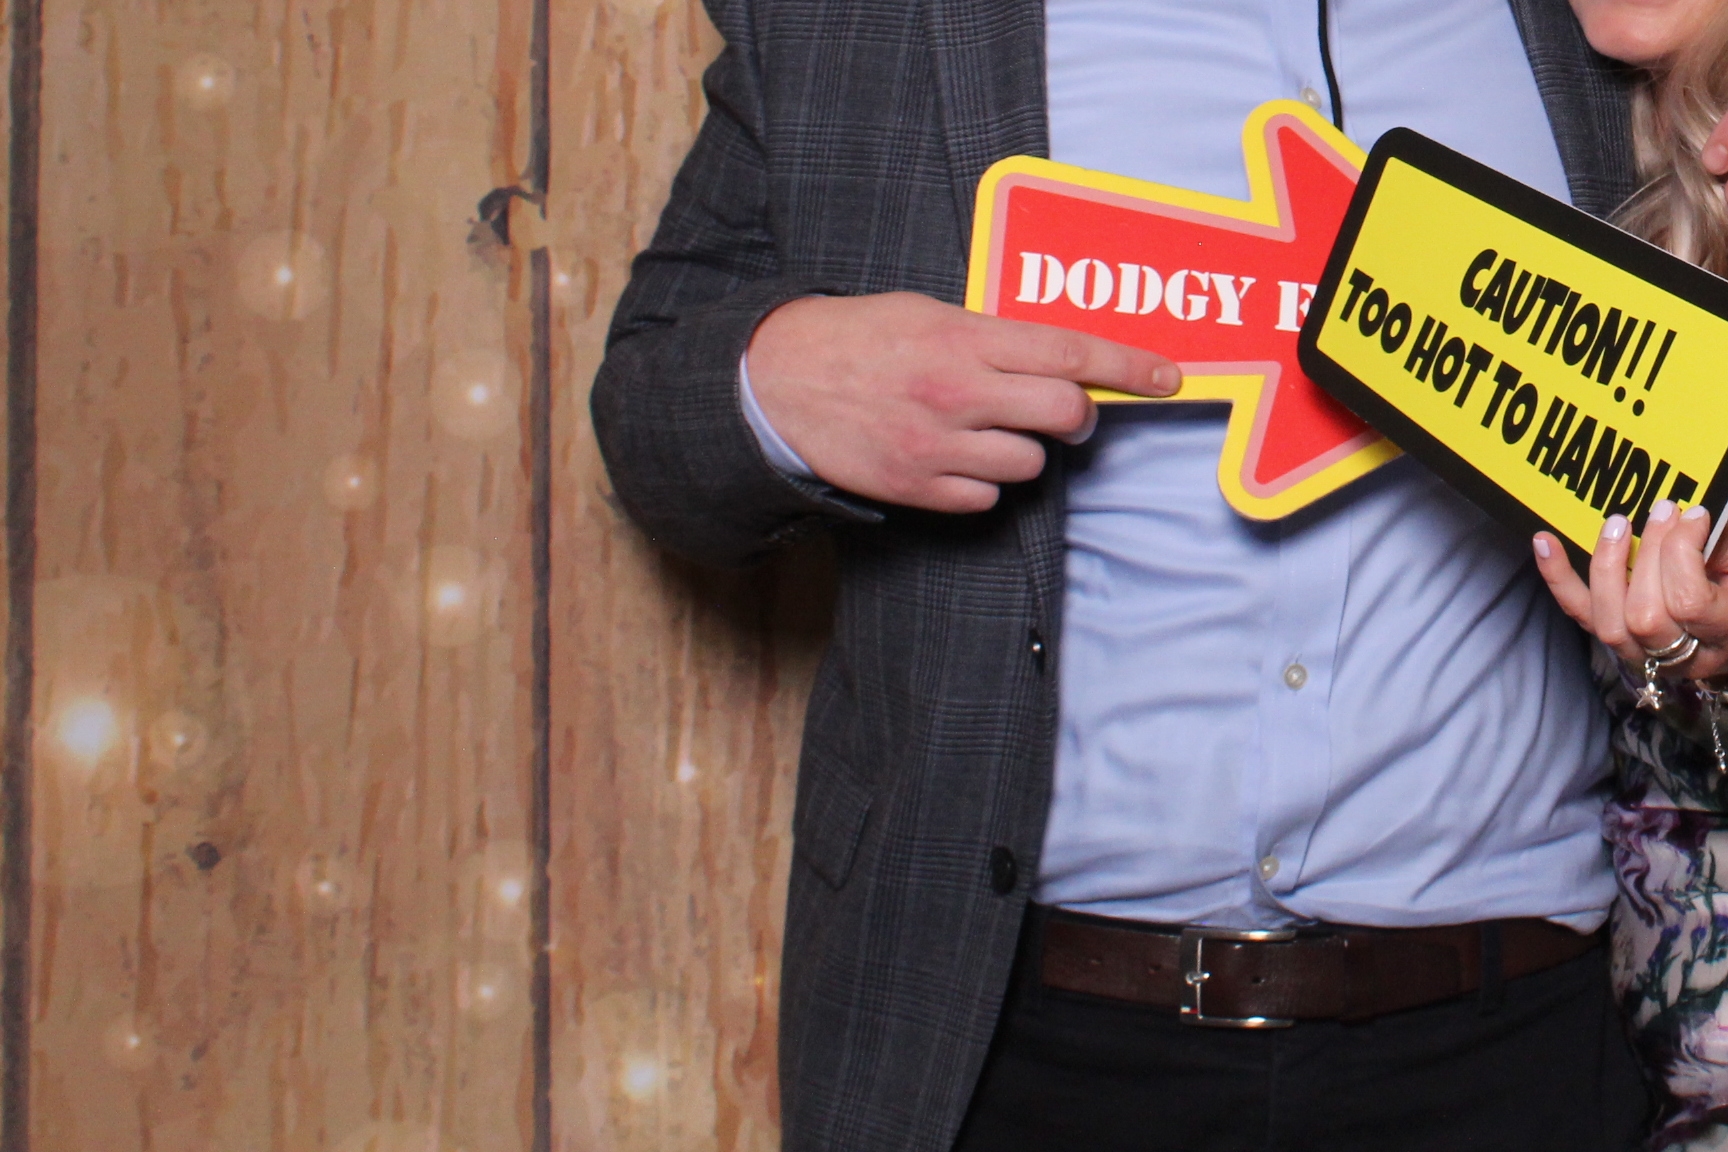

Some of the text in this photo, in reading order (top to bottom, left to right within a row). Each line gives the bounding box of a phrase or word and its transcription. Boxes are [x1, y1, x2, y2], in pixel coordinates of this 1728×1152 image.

[1015, 251, 1257, 327] DODGY
[1339, 268, 1412, 354] TOO
[1403, 315, 1494, 409] HOT
[1480, 360, 1538, 445] TO
[1459, 248, 1677, 417] CAUTION!!
